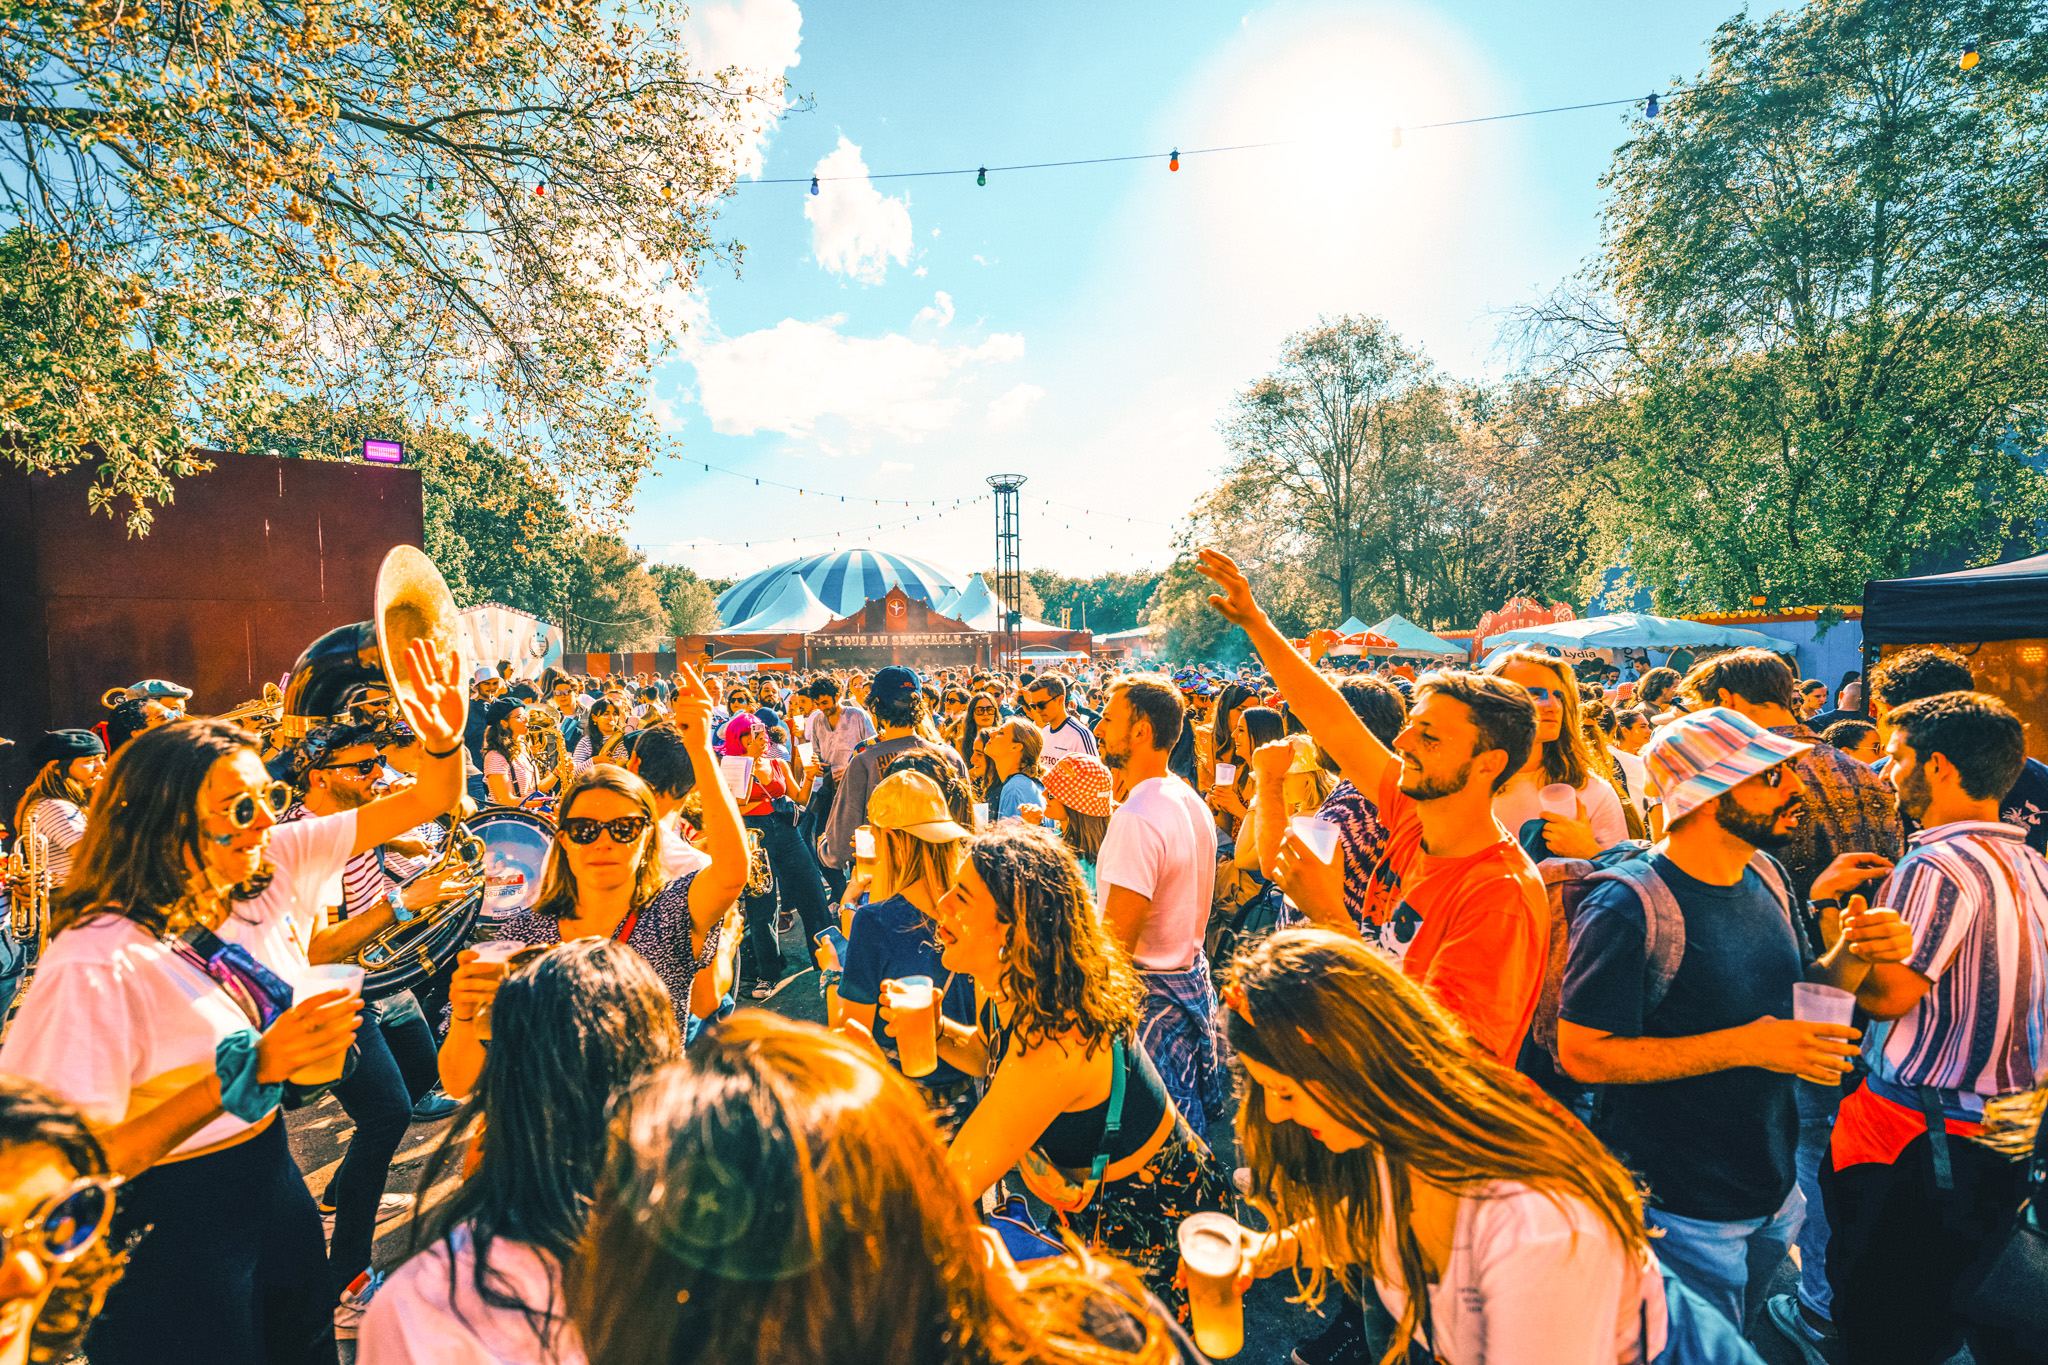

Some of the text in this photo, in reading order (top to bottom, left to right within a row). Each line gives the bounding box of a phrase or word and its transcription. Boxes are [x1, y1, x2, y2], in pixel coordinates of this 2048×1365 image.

[834, 634, 961, 646] TOUS AU SPECTACLE
[1563, 649, 1597, 659] Lydia
